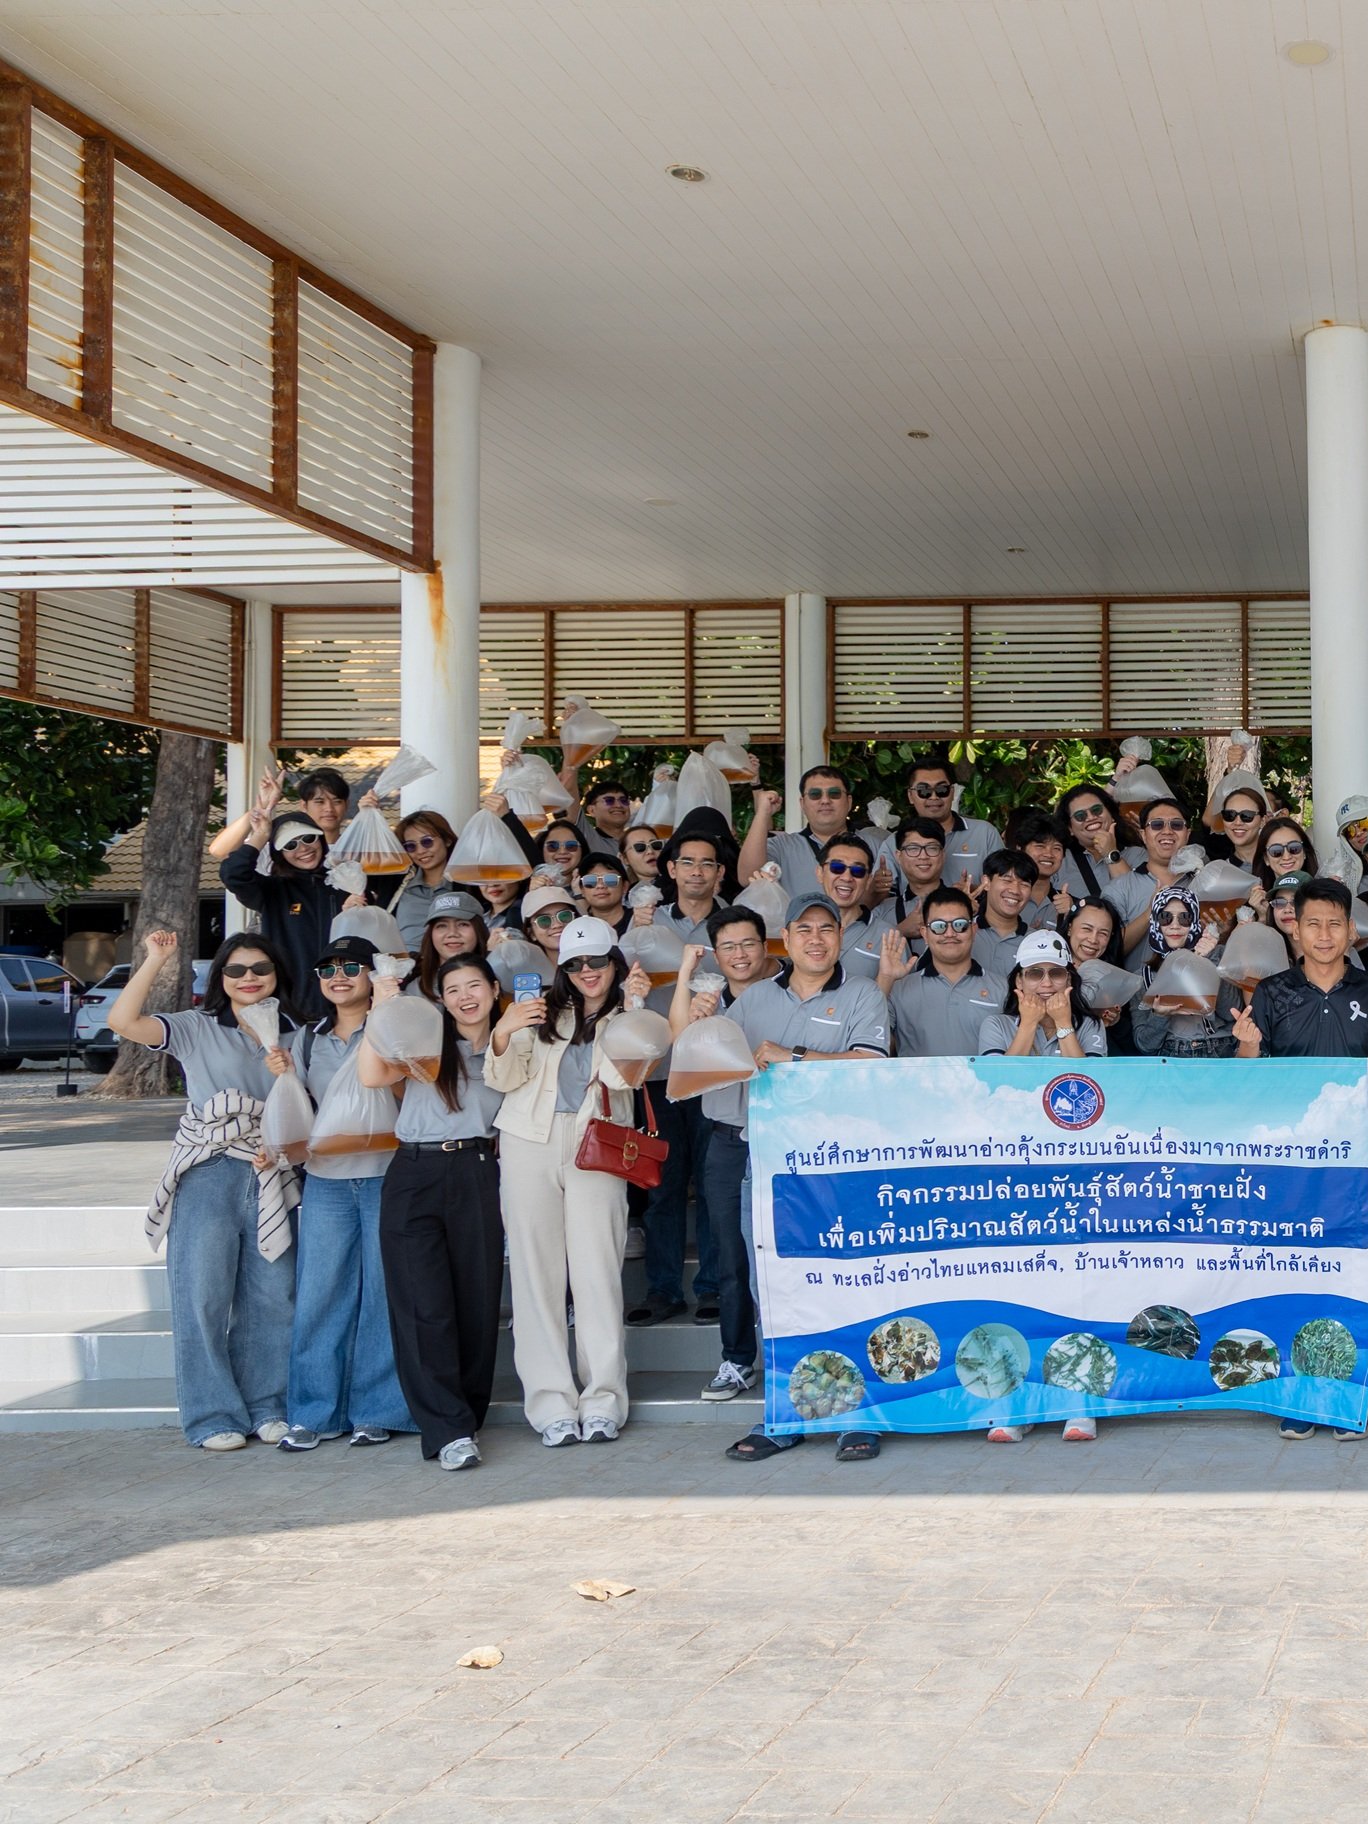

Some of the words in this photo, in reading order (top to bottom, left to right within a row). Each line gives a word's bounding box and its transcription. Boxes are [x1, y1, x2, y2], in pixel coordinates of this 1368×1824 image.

[785, 1127, 1352, 1175] ศูนย์ศึกษาการพัฒนาอ่าวคุ้งกระเบนอันเนื่องมาจากพระราชดำริ
[876, 1165, 1267, 1207] กิจกรรมปล่อยพันธุ์สัตว์น้ำชายฝั่ง
[818, 1201, 1325, 1249] เพื่อเพิ่มปริมาณสัตว์น้ำในแหล่งน้ำธรรมชาติ
[805, 1272, 823, 1285] ณ
[832, 1250, 1064, 1287] ทะเลฝั่งอ่าวไทยแหลมเสด็จ,
[1075, 1250, 1184, 1271] บ้านเจ้าหลาว
[1196, 1247, 1342, 1273] และพื้นที่ใกล้เคียง
